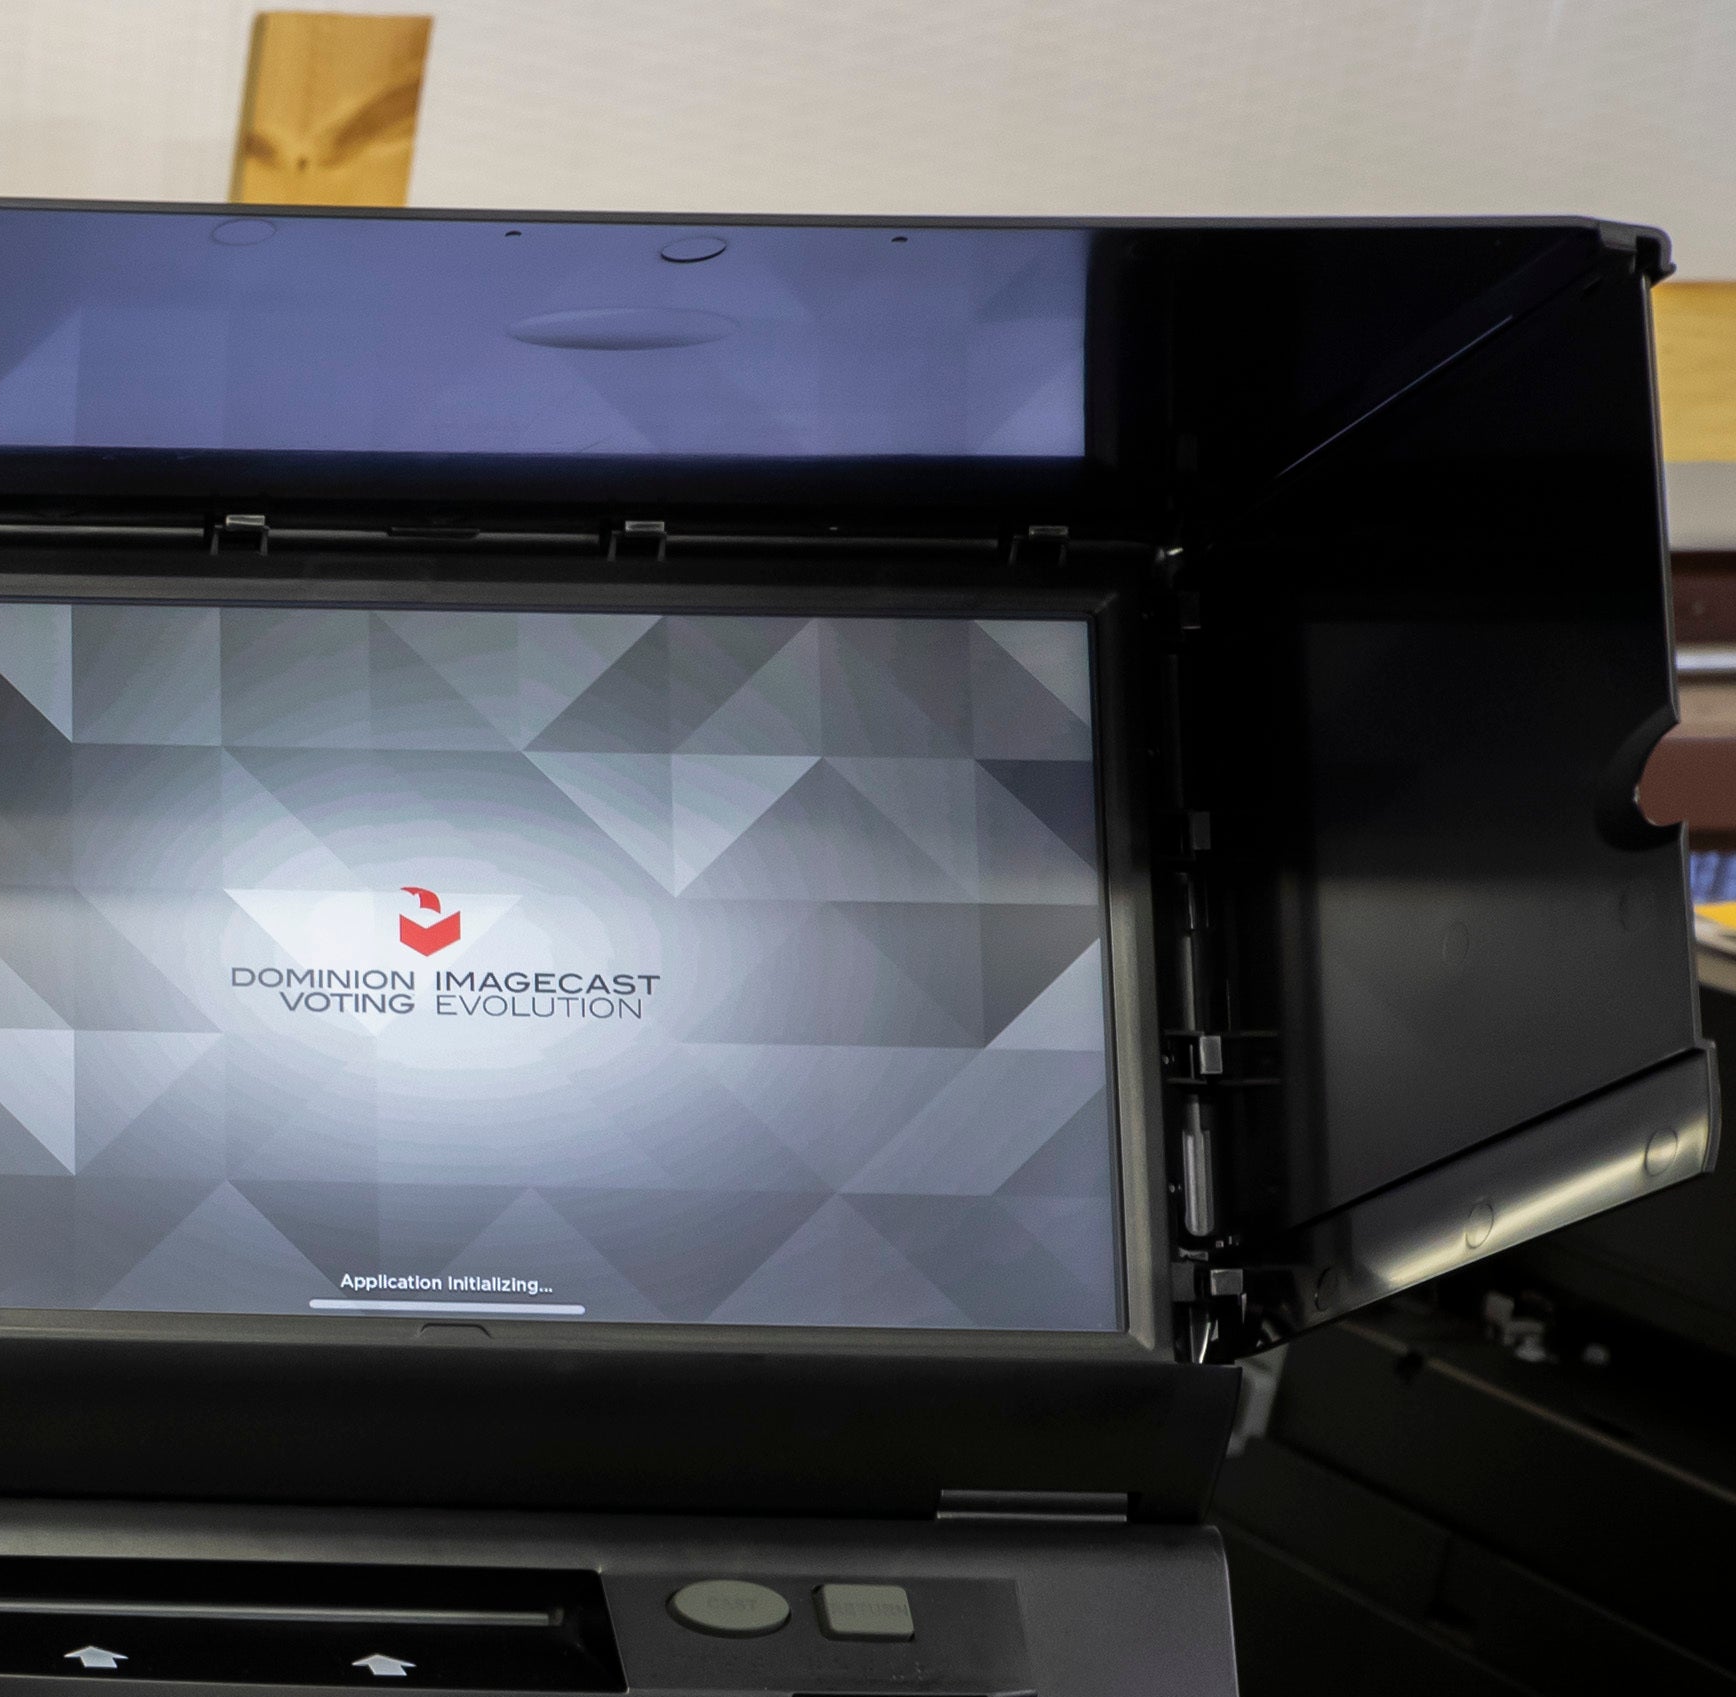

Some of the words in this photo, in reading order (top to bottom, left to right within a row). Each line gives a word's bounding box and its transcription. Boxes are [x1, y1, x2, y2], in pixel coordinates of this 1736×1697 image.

[231, 967, 416, 990] DOMINION
[435, 971, 661, 996] IMAGECAST
[279, 992, 416, 1014] VOTING
[436, 995, 642, 1020] EVOLUTION
[340, 1273, 443, 1292] Application
[448, 1275, 553, 1295] Initializing...
